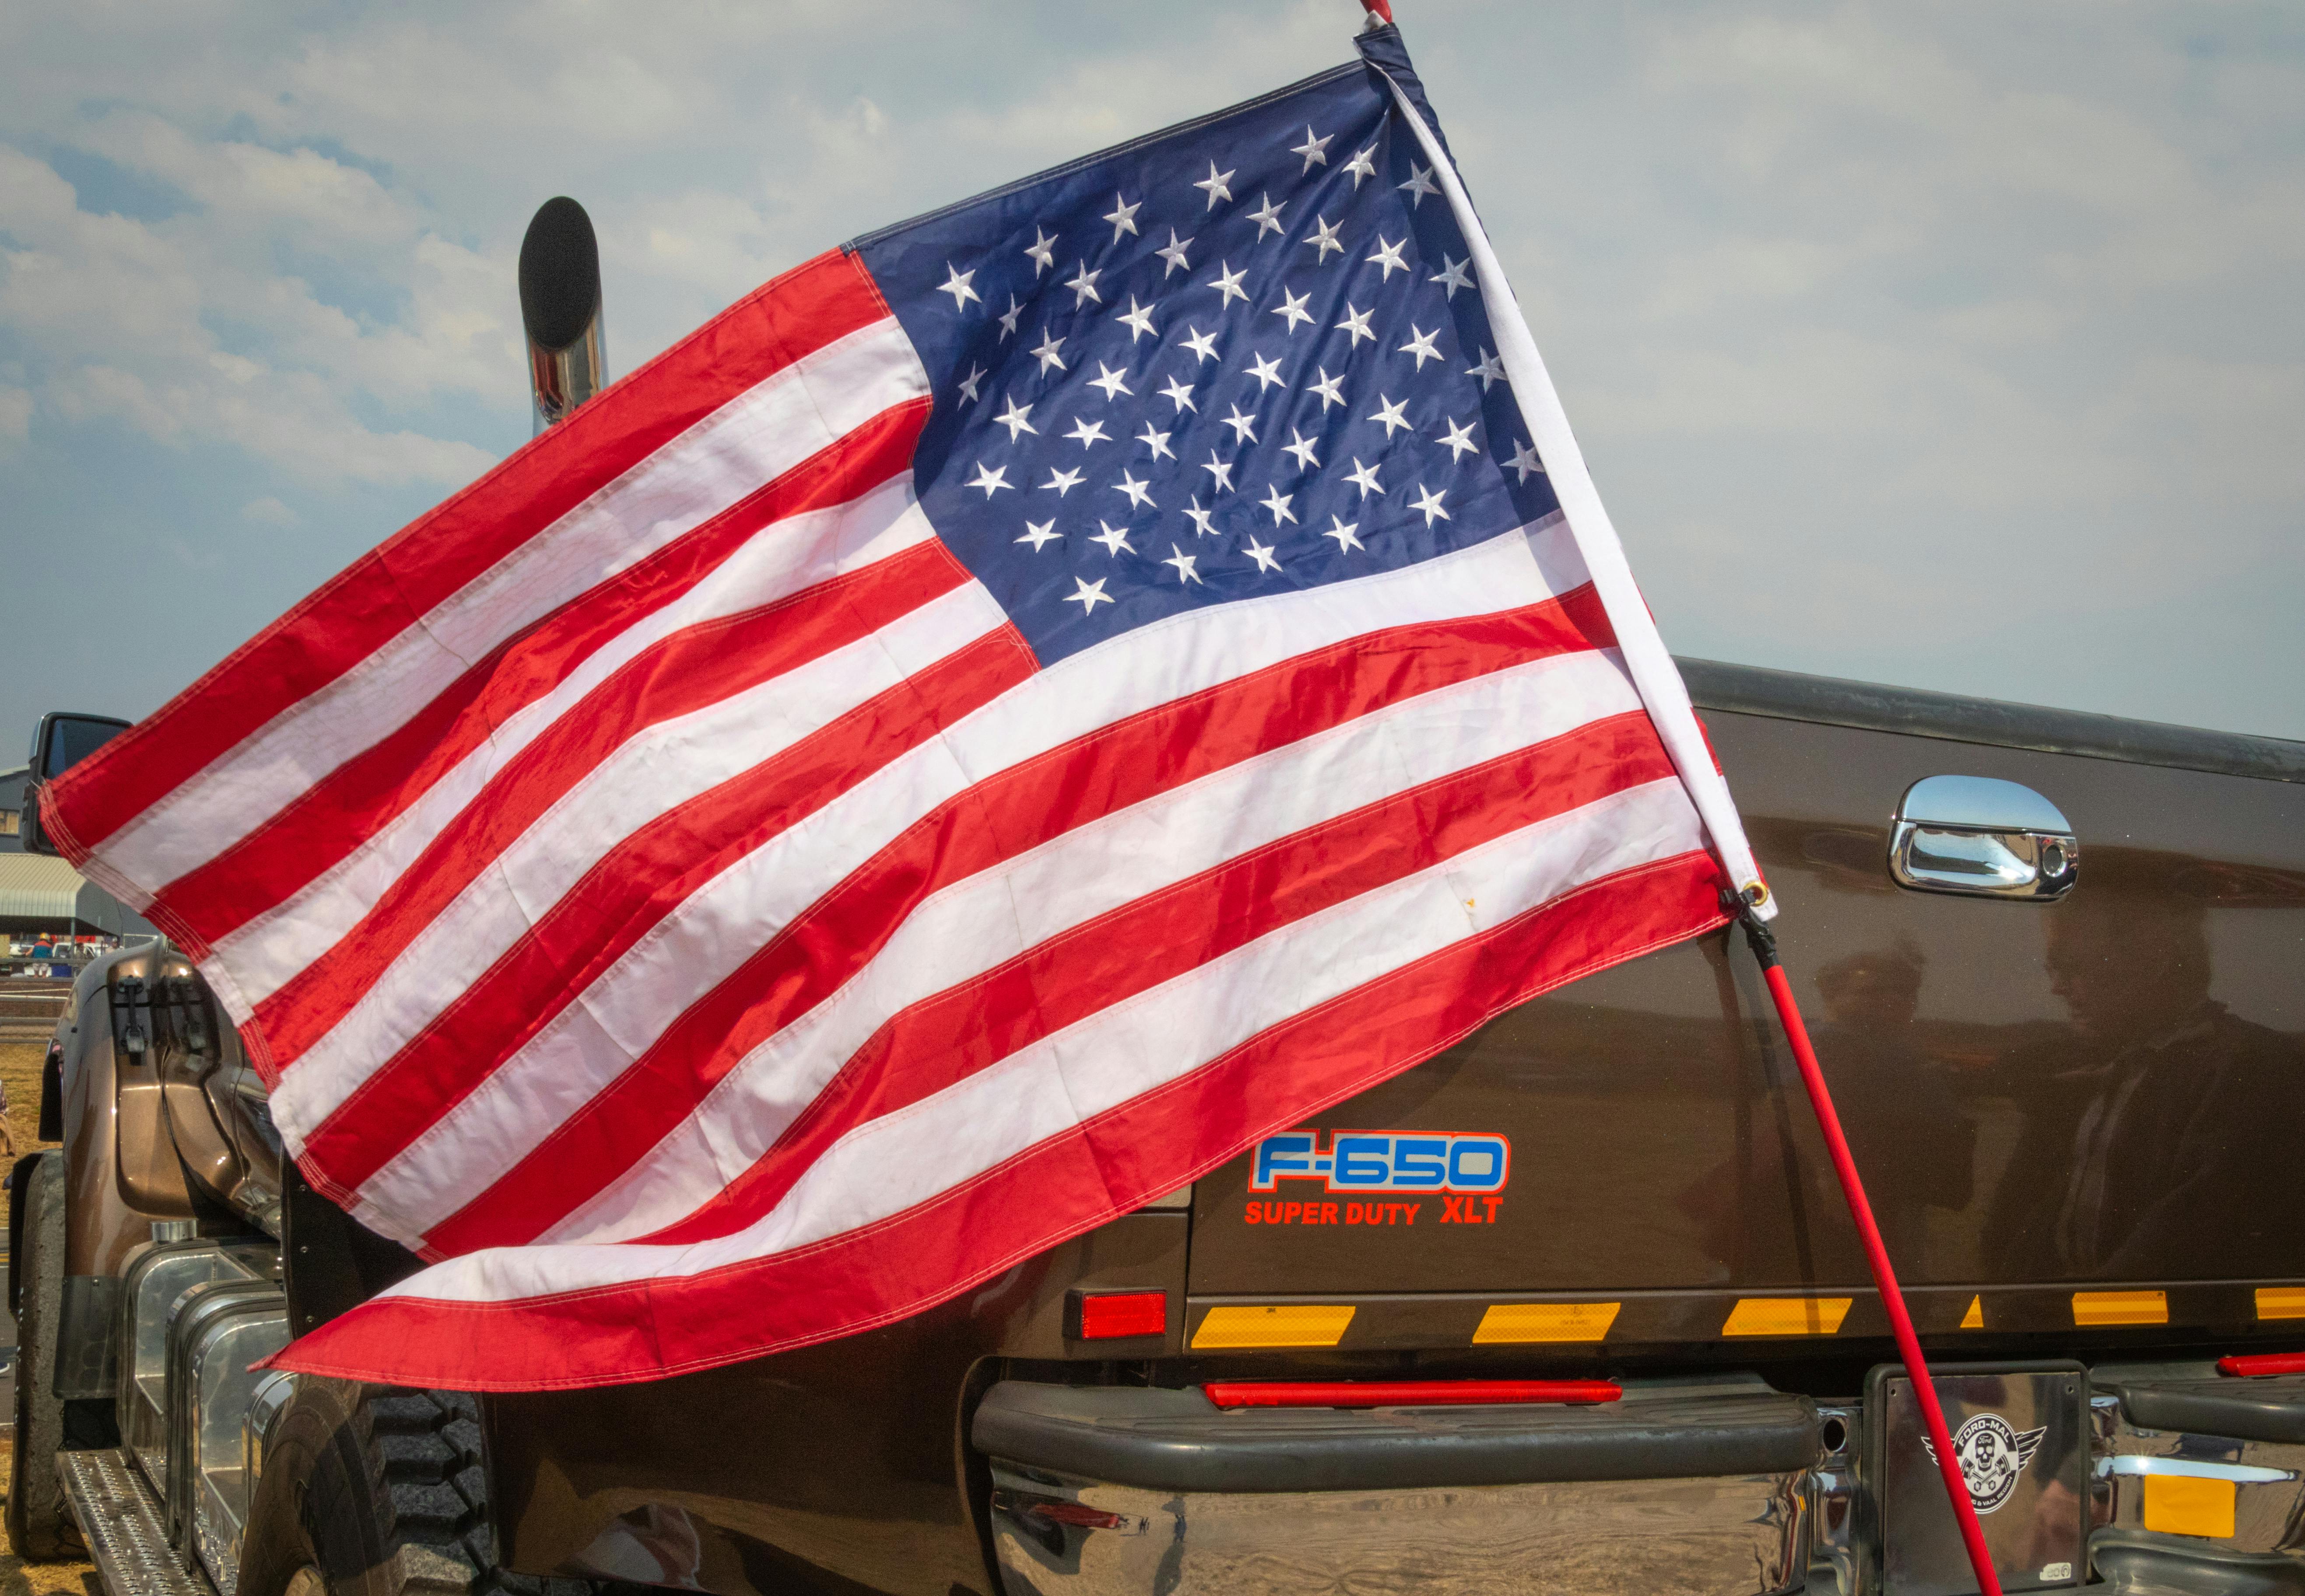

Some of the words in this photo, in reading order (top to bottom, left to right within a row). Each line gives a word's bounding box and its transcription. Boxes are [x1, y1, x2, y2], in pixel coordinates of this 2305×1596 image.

[1251, 1131, 1509, 1192] F-650
[1245, 1201, 1338, 1224] SUPER
[1346, 1202, 1421, 1225] DUTY
[1439, 1197, 1503, 1224] XLT
[1958, 1420, 2010, 1447] FORD-MAL
[1978, 1435, 1992, 1444] Ford
[1996, 1476, 2013, 1499] REGION
